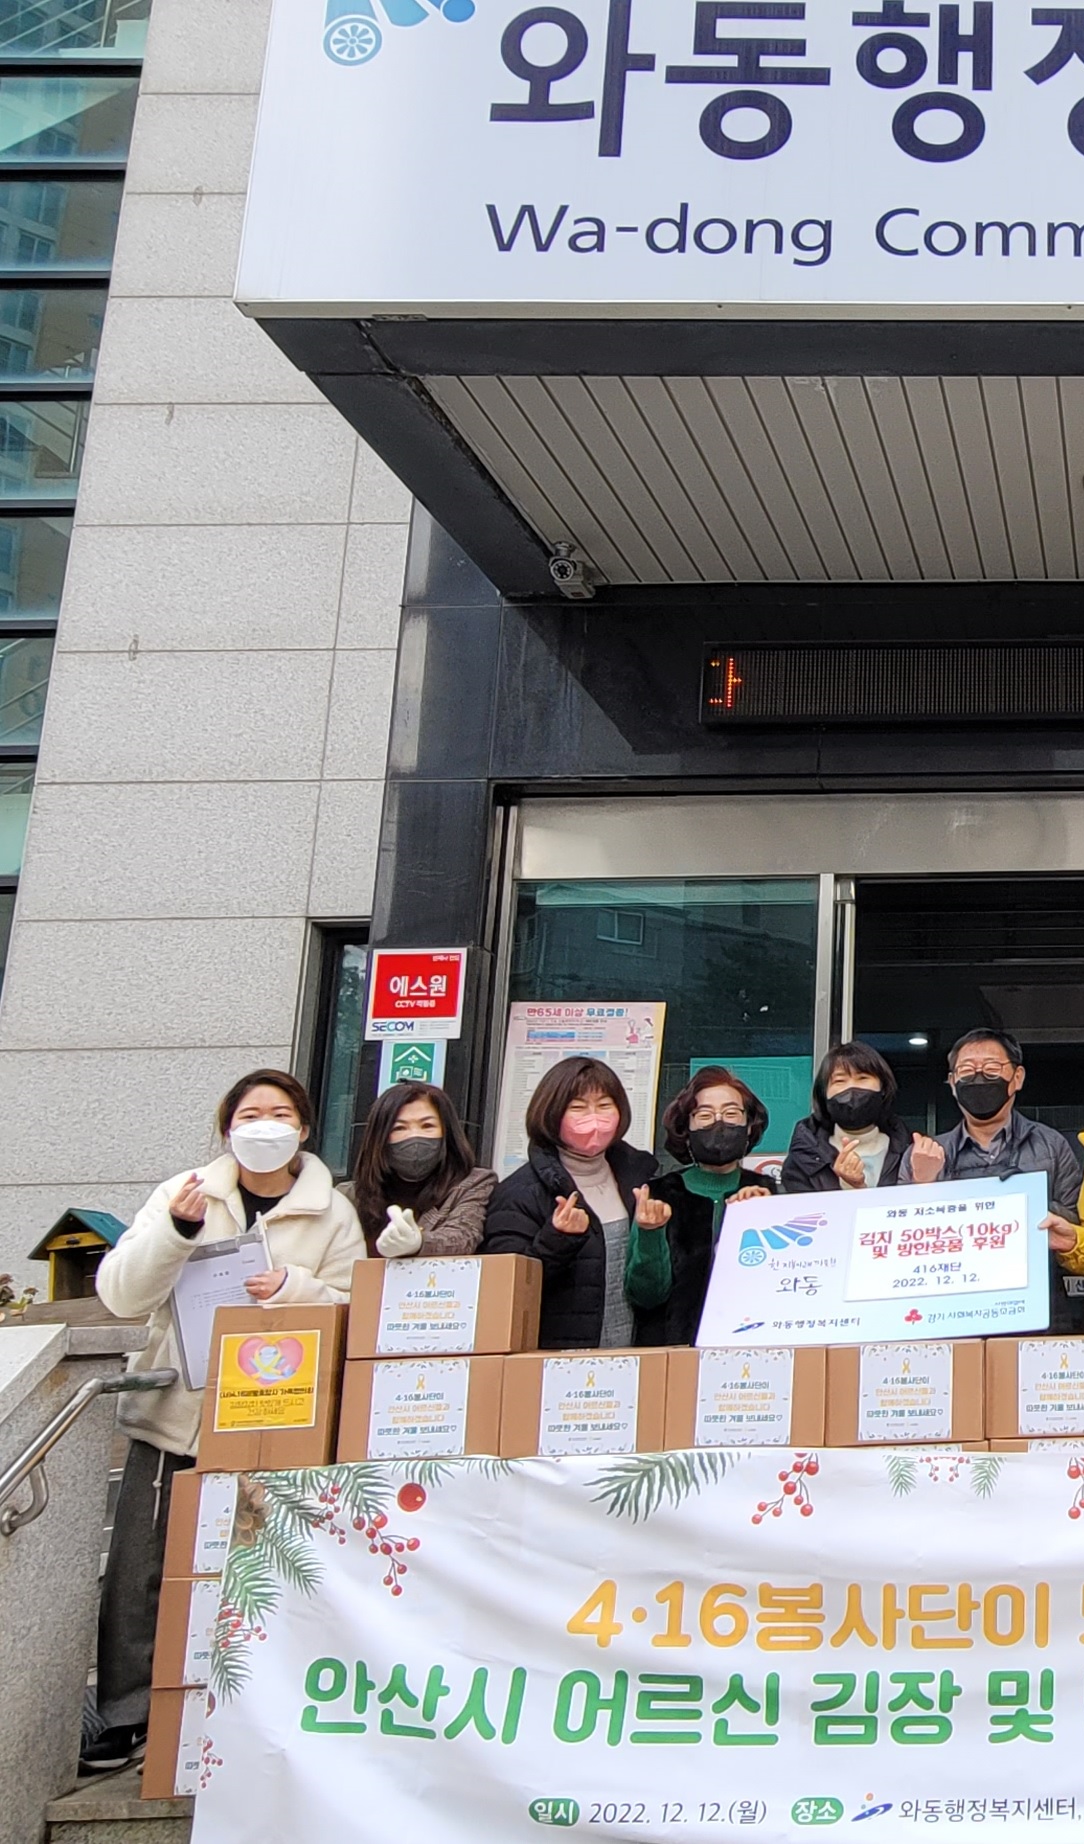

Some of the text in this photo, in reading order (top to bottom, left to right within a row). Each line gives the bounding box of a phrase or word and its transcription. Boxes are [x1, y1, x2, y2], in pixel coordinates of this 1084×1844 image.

[486, 202, 834, 266] Wa-dong
[389, 975, 447, 997] 에스원
[565, 1008, 584, 1017] 이상
[371, 1021, 414, 1032] SECOM
[972, 1235, 1006, 1251] 후원
[776, 1276, 823, 1296] 와동
[893, 1273, 980, 1288] 2022. 12. 12.
[566, 1579, 1050, 1651] 4·16봉사단이
[300, 1656, 527, 1745] 안산시
[552, 1668, 780, 1747] 어르신
[809, 1668, 963, 1747] 김장
[987, 1667, 1055, 1745] 및
[533, 1802, 575, 1824] 일시
[588, 1800, 652, 1824] 2022.
[660, 1800, 689, 1823] 12.
[697, 1799, 767, 1825] 12.(월)
[794, 1799, 839, 1823] 장소
[898, 1796, 1082, 1823] 와동행정복지센터,
